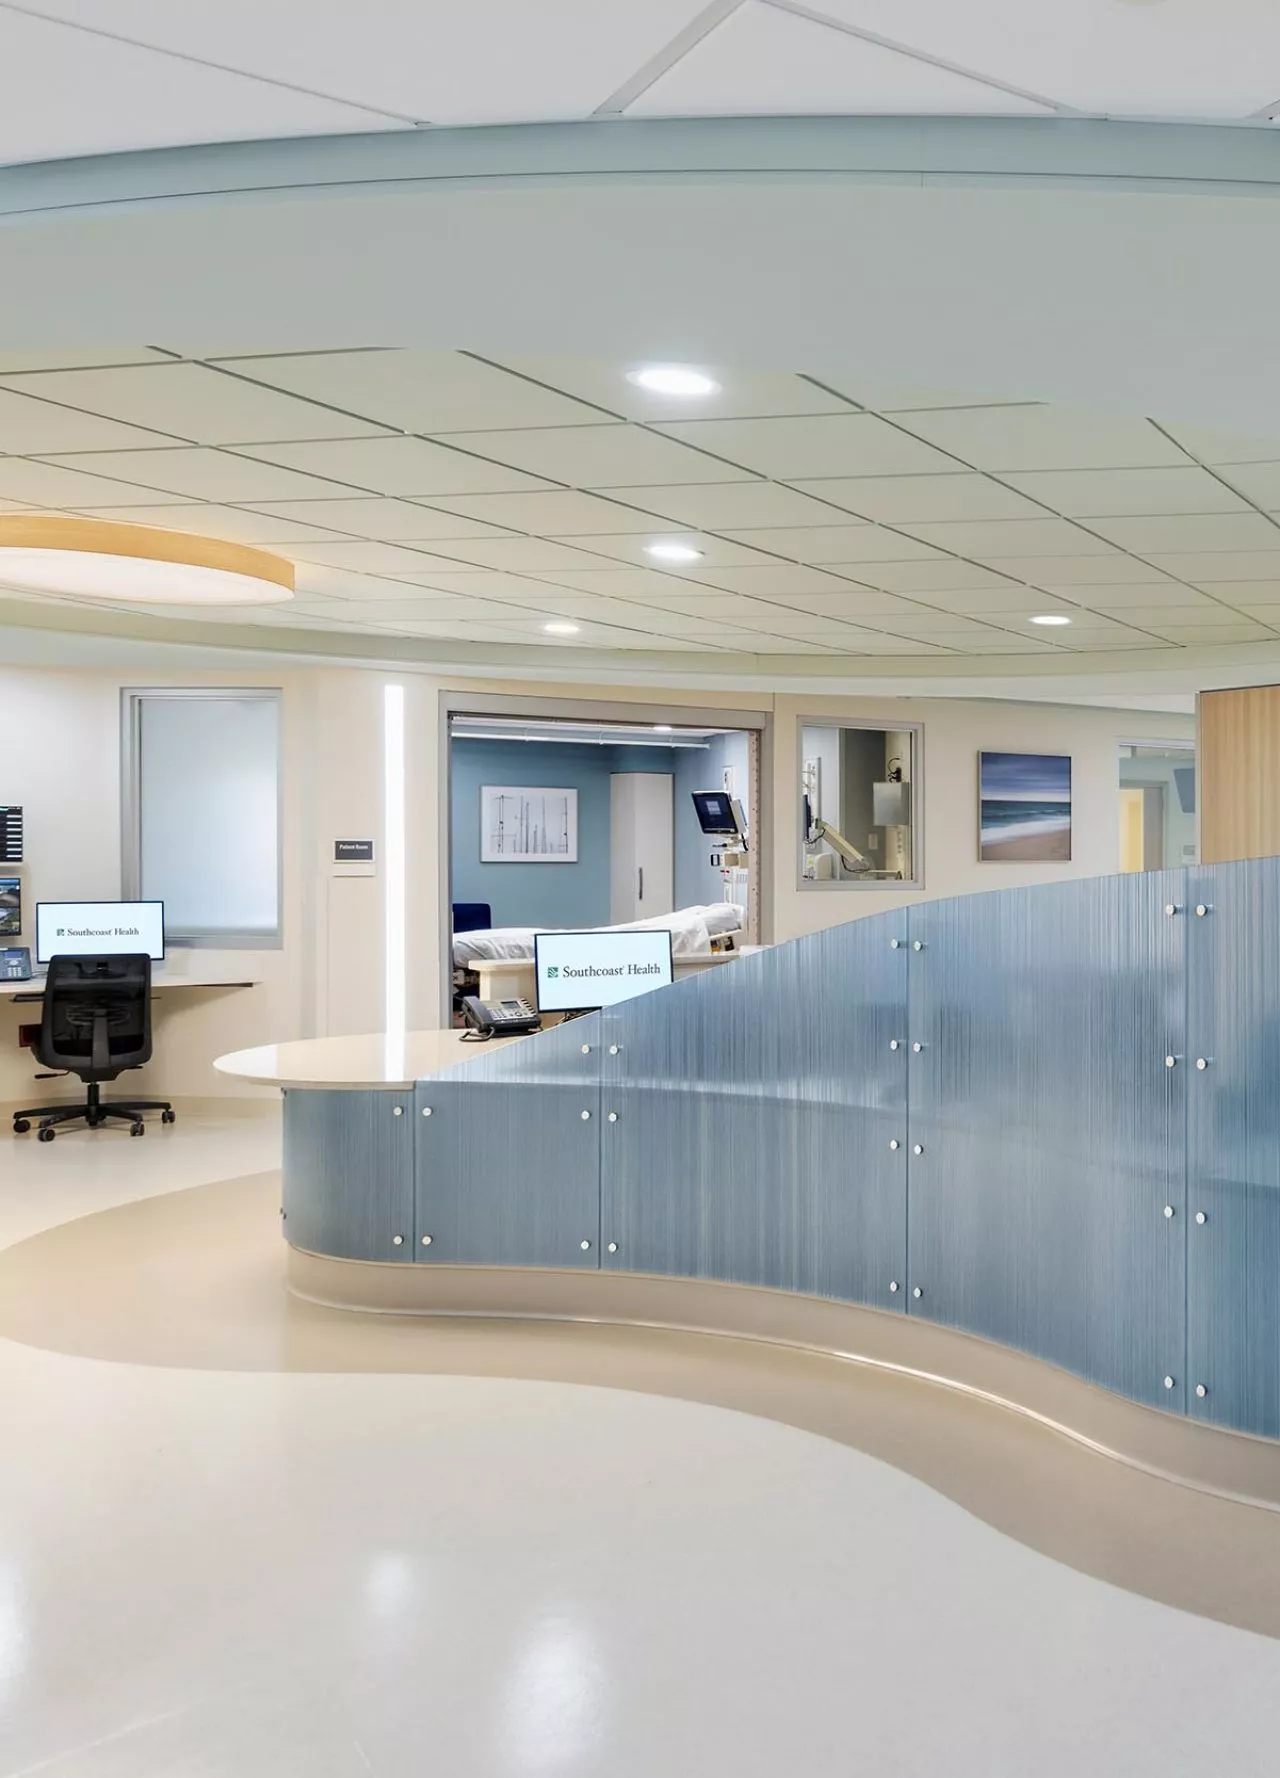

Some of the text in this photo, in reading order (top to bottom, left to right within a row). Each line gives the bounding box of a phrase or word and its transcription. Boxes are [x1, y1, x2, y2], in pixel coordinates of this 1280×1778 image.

[67, 927, 140, 936] Southcoast Health
[562, 963, 661, 978] Southcoast Health
